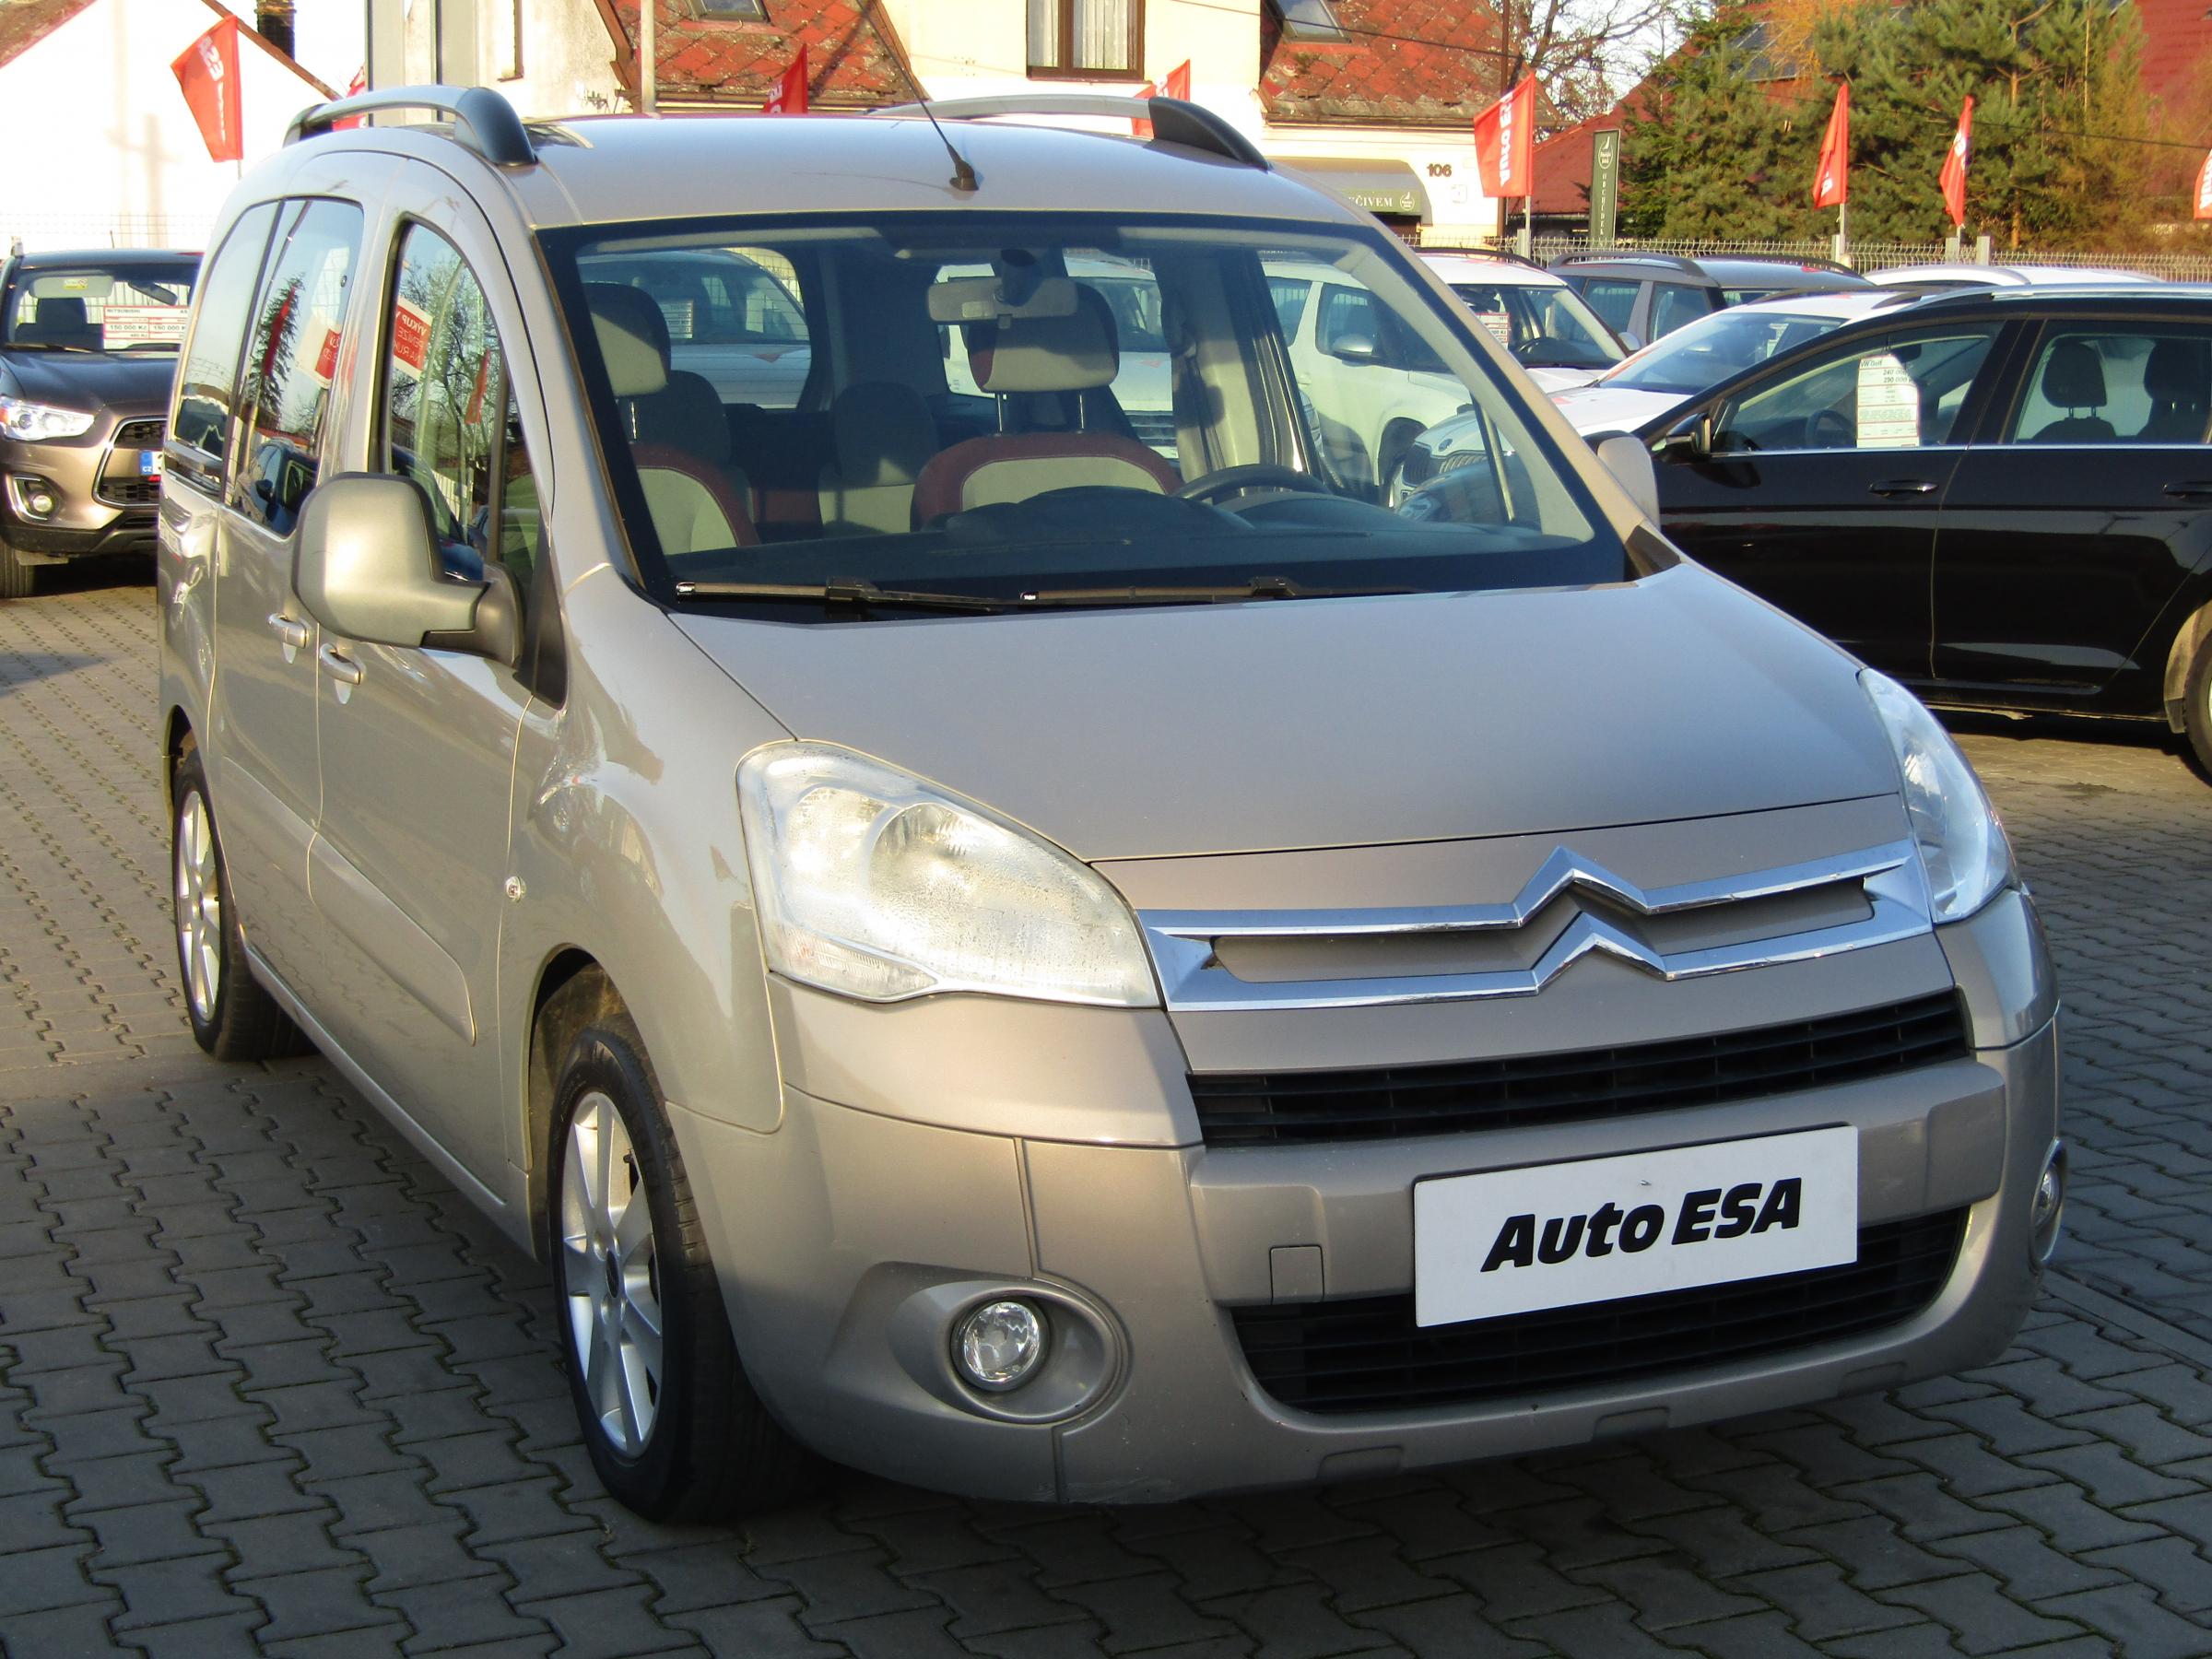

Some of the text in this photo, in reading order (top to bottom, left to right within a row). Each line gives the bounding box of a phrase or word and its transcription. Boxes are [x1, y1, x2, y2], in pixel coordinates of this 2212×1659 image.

[1427, 163, 1452, 177] 106
[1480, 1177, 1802, 1272] Auto ESA
